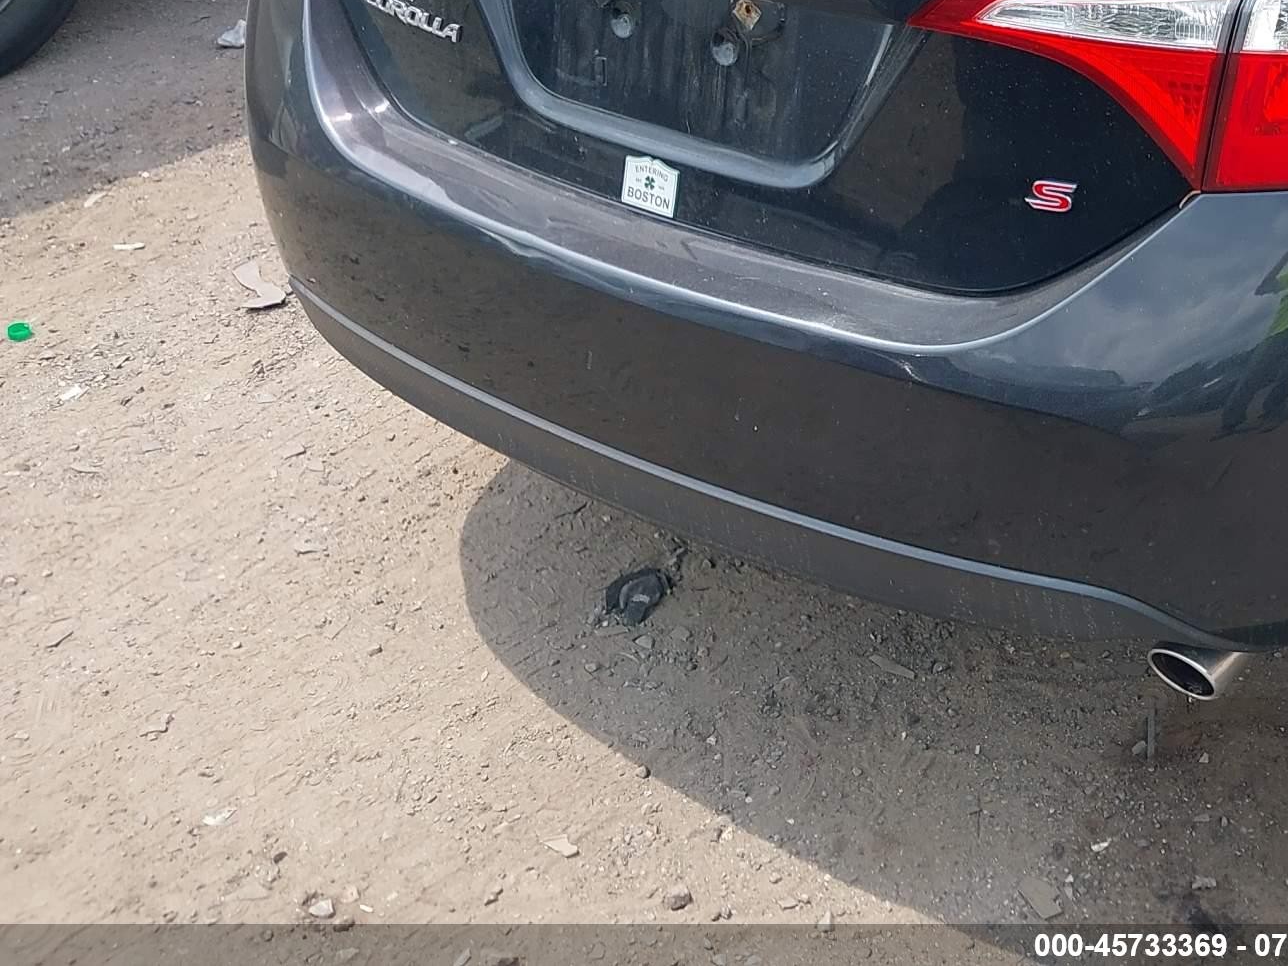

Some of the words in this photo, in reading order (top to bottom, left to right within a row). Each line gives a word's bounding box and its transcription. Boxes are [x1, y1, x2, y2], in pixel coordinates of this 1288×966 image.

[635, 164, 669, 182] ENTERING
[627, 186, 670, 209] BOSTON
[1024, 180, 1077, 212] S
